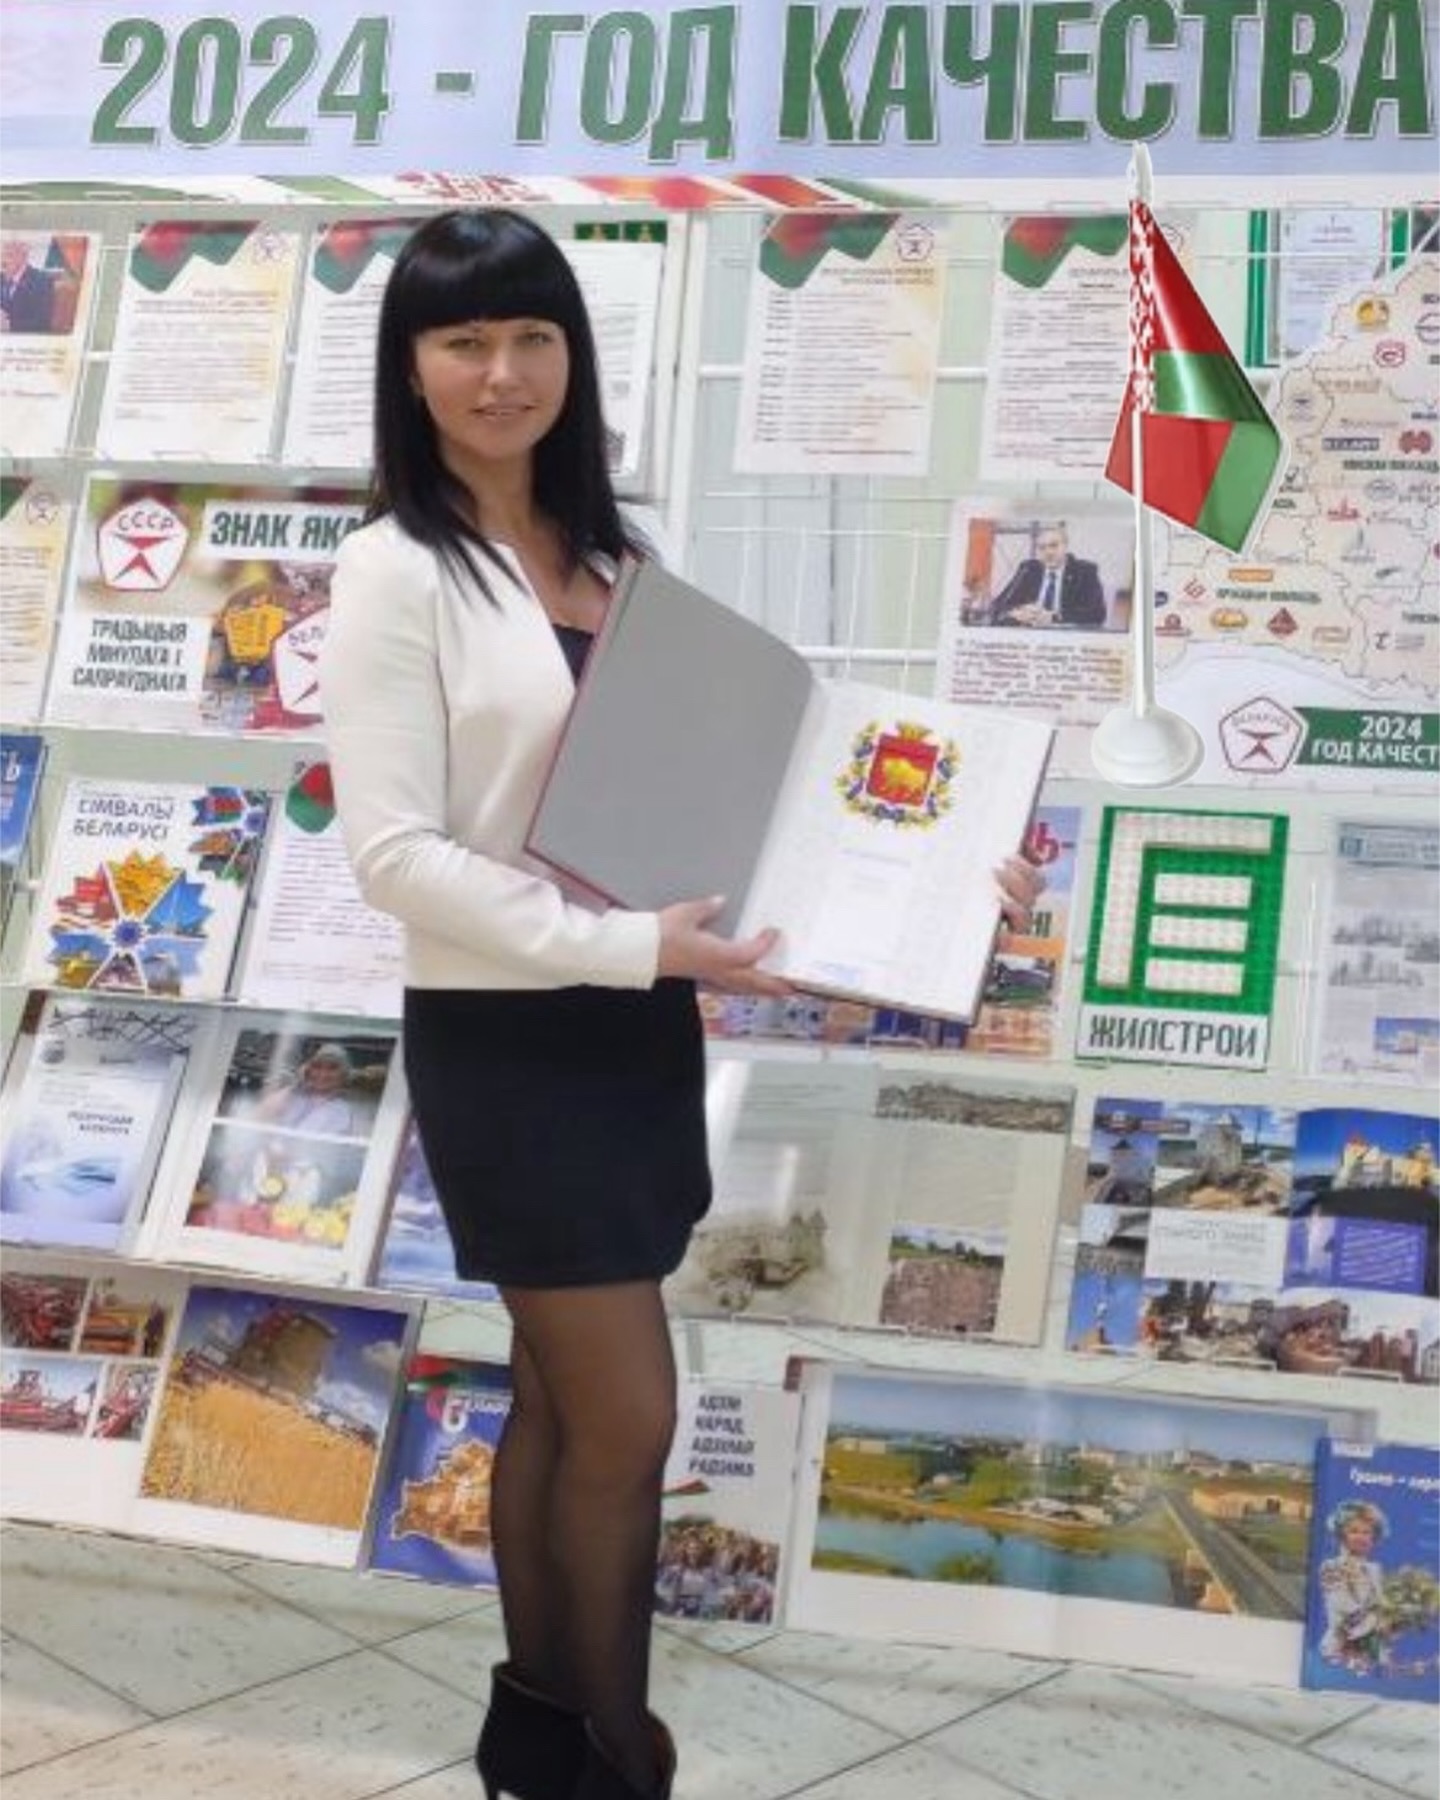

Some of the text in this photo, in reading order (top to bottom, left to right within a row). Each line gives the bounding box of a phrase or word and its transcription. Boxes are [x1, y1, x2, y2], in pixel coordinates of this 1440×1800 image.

[90, 0, 1435, 162] 2024 - ГОД КАЧЕСТВА
[117, 510, 175, 533] СССР
[210, 511, 292, 548] ЗНАК
[1359, 716, 1422, 740] 2024
[1311, 739, 1354, 763] ГОД
